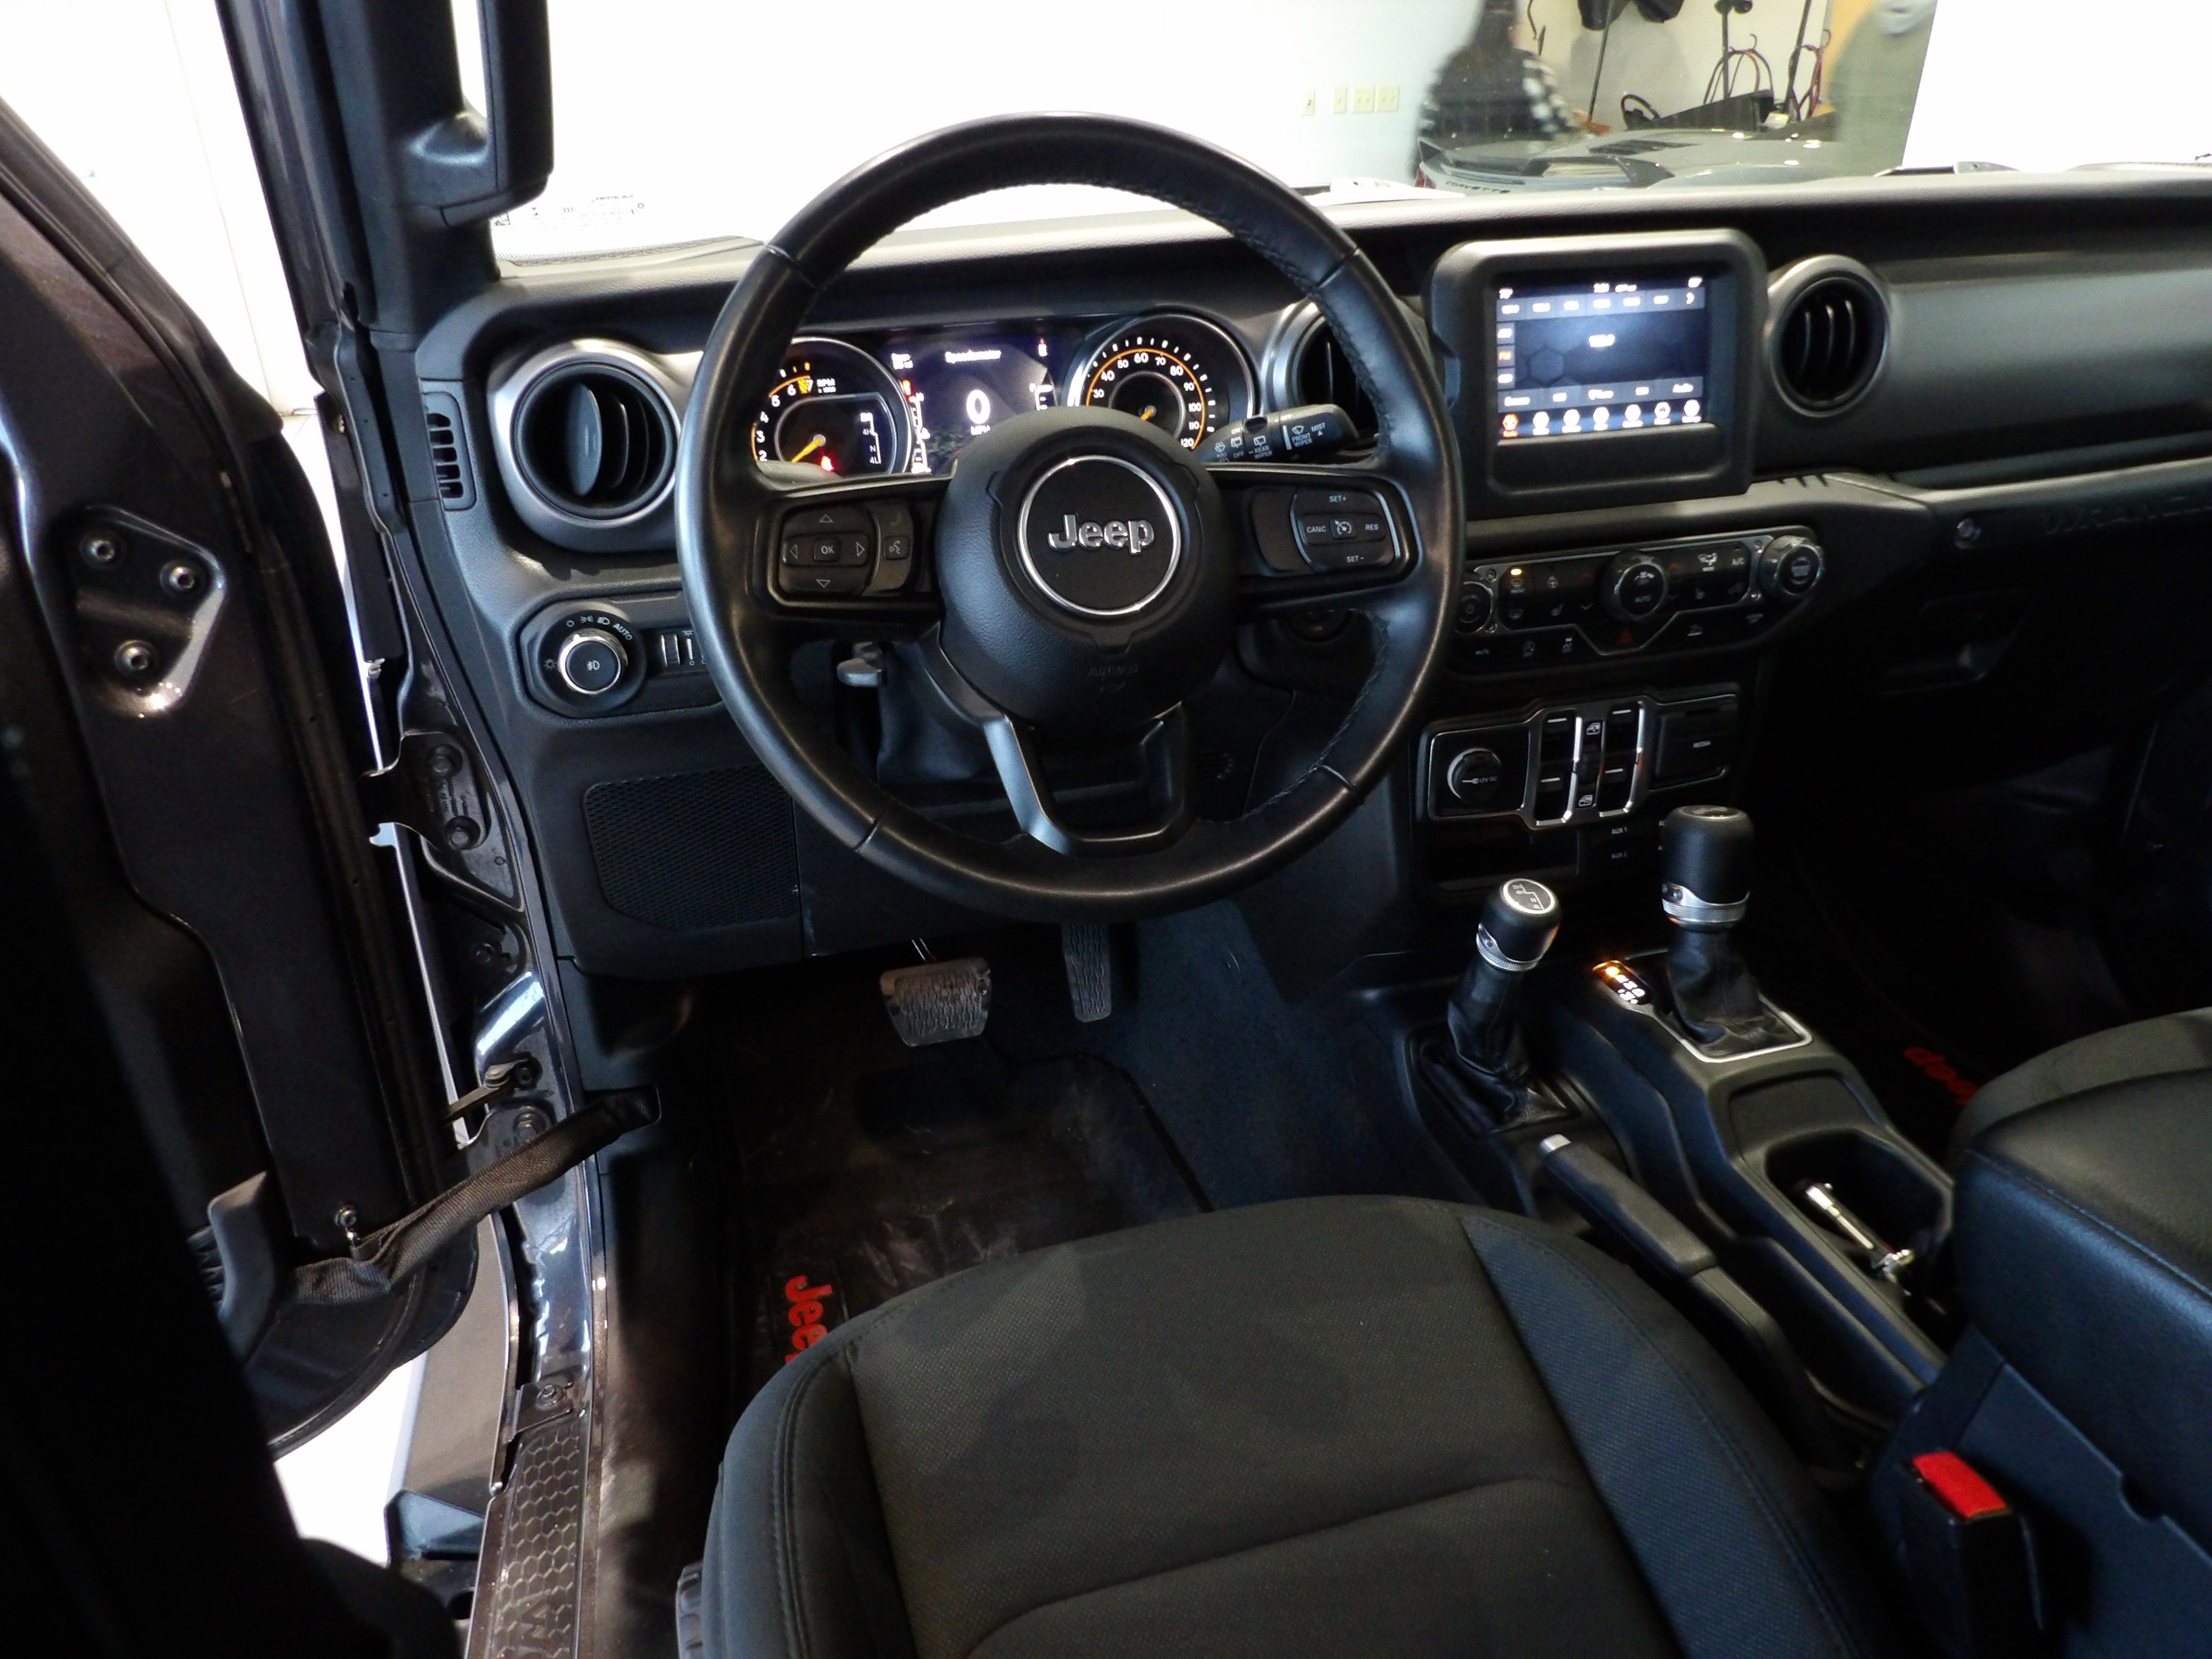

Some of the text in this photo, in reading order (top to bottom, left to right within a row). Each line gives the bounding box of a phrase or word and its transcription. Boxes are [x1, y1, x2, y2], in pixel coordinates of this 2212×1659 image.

[1134, 352, 1149, 363] 60
[1155, 357, 1166, 366] 70
[1117, 360, 1129, 369] 50
[1101, 370, 1115, 381] 40
[1170, 365, 1184, 376] 80
[787, 384, 796, 396] 6
[805, 379, 813, 392] 7
[1183, 382, 1194, 391] 90
[1094, 389, 1104, 398] 30
[771, 395, 781, 407] 5
[966, 390, 990, 424] 0
[1189, 402, 1202, 412] 100
[760, 411, 769, 423] 4
[1189, 421, 1200, 430] 110
[1311, 422, 1326, 432] MIST
[756, 430, 765, 443] 3
[1292, 432, 1310, 442] FRONT
[1181, 438, 1194, 447] 120
[1294, 438, 1313, 447] WIPER
[1254, 445, 1270, 454] REAR
[758, 450, 768, 461] 2
[1047, 514, 1154, 555] Jeep
[821, 545, 835, 554] OK
[613, 623, 633, 640] AUTO
[785, 1274, 833, 1364] Jee
